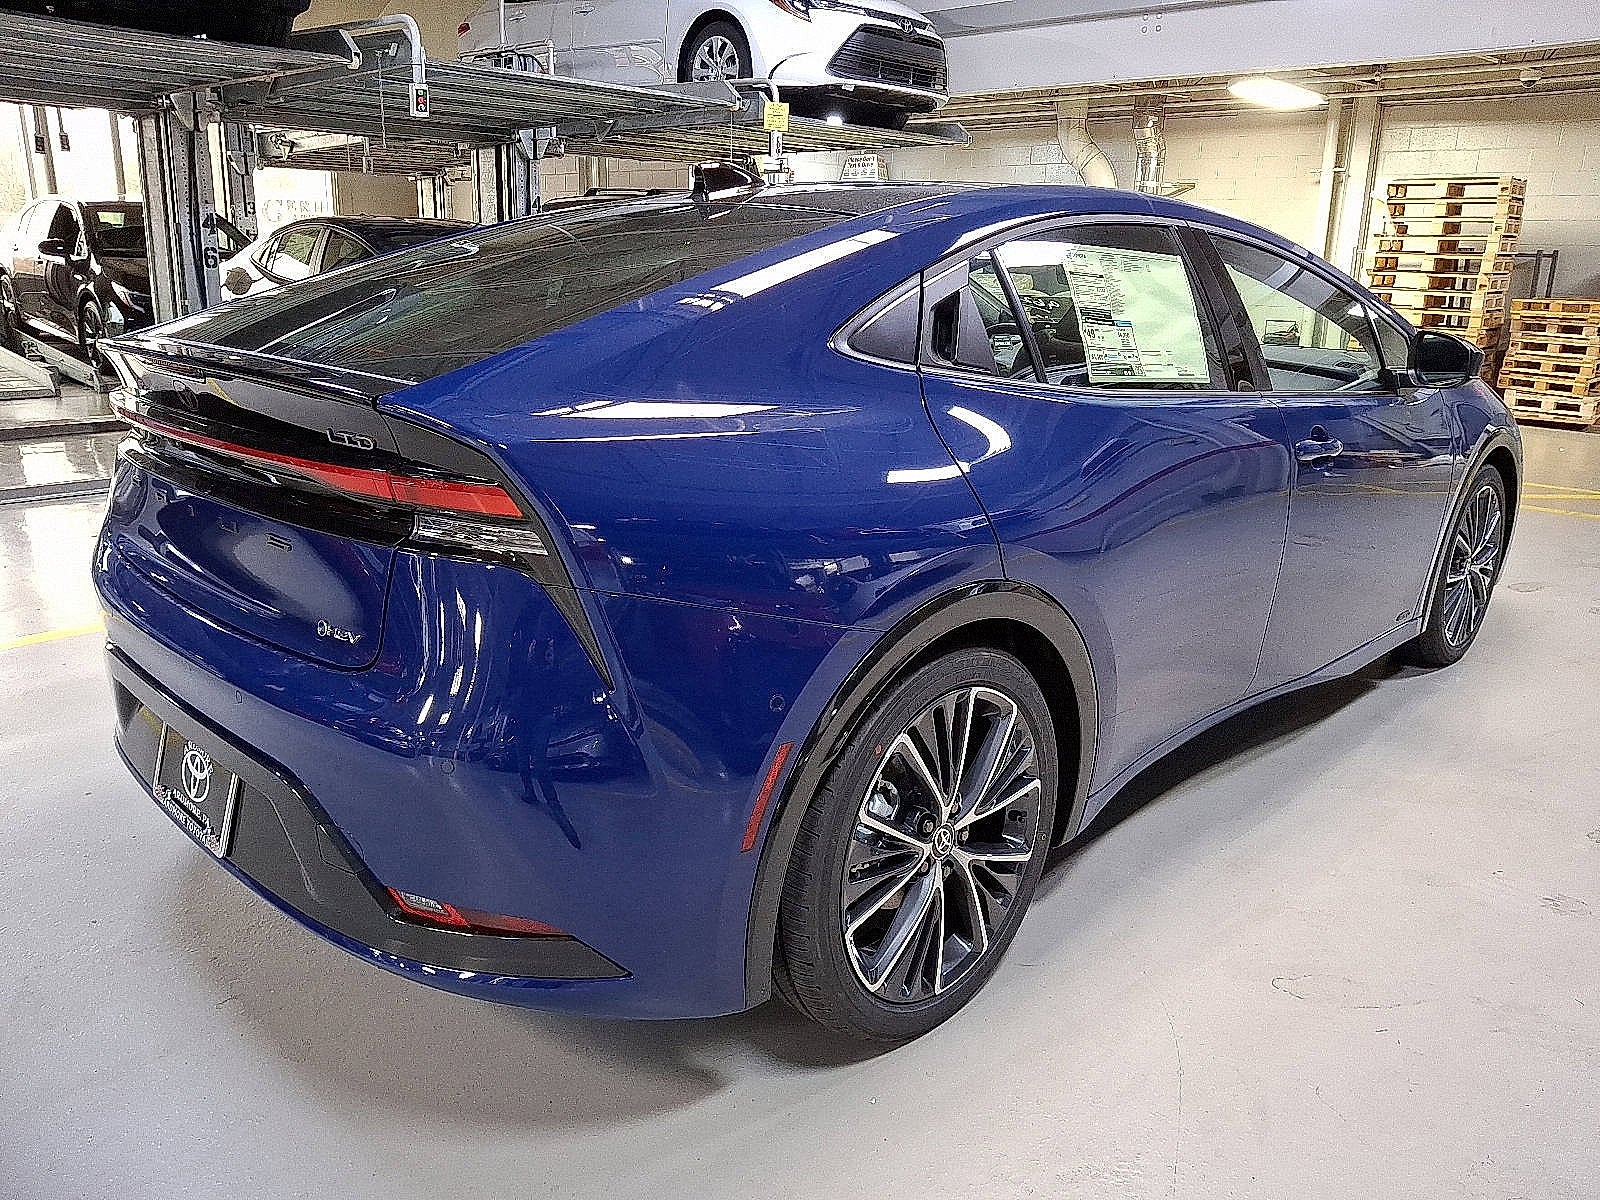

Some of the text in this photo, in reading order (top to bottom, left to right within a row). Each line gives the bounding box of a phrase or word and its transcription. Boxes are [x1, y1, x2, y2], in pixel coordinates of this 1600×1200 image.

[201, 212, 216, 235] 4
[203, 246, 218, 269] 6
[325, 427, 374, 450] LTD
